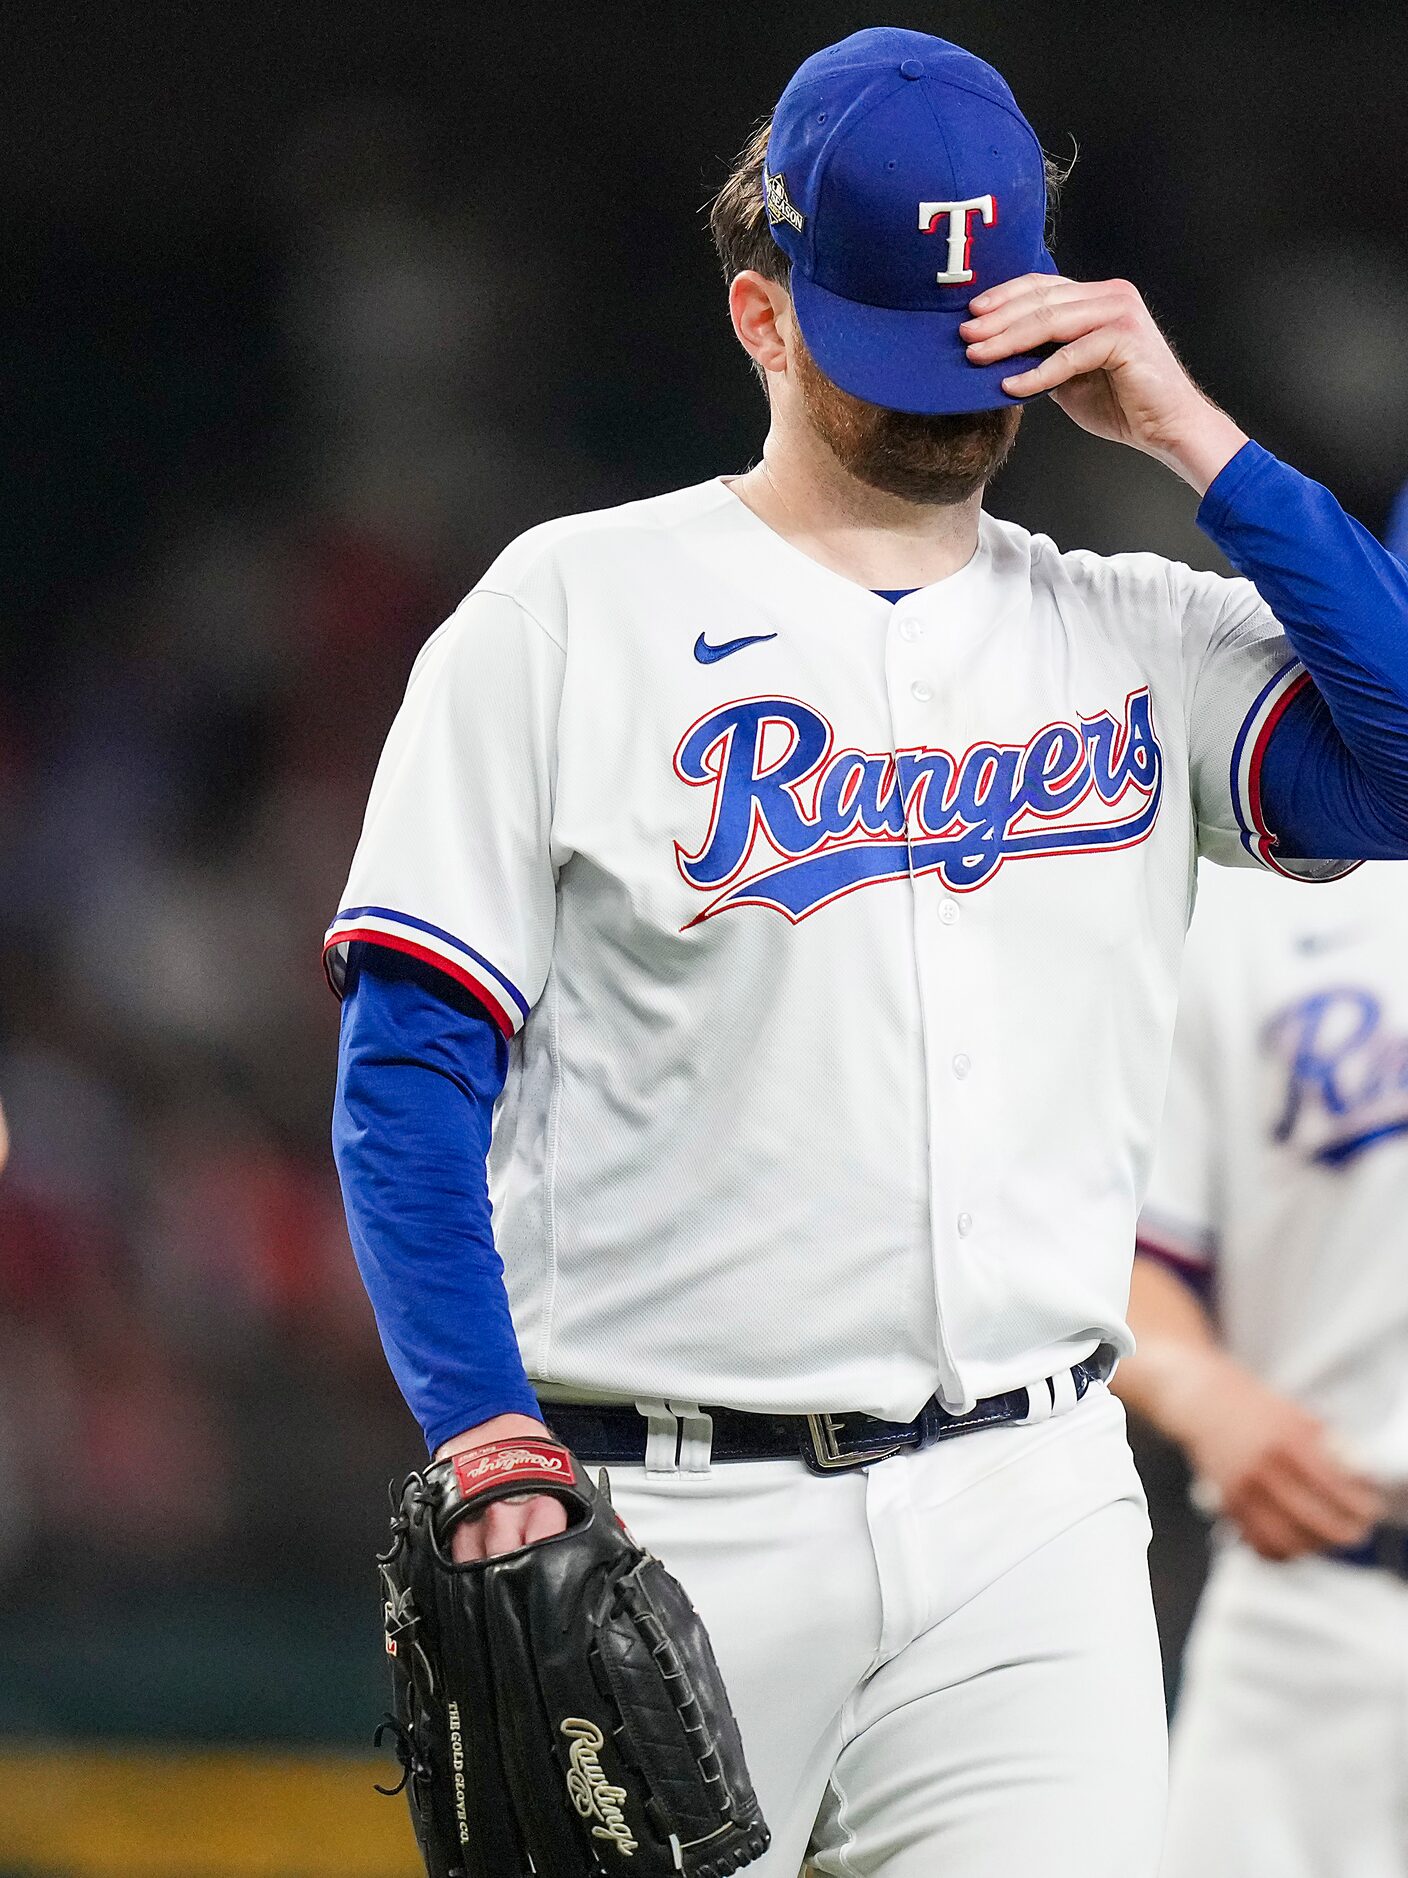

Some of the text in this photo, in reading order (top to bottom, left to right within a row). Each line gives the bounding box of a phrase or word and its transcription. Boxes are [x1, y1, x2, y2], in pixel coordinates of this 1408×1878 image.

[918, 194, 997, 289] T
[673, 685, 1164, 932] Rangers
[467, 1448, 562, 1478] Rawlings
[448, 1701, 460, 1730] THE
[451, 1731, 464, 1772] GOLD
[455, 1773, 467, 1820] GLOVE
[561, 1717, 638, 1856] Rawlings
